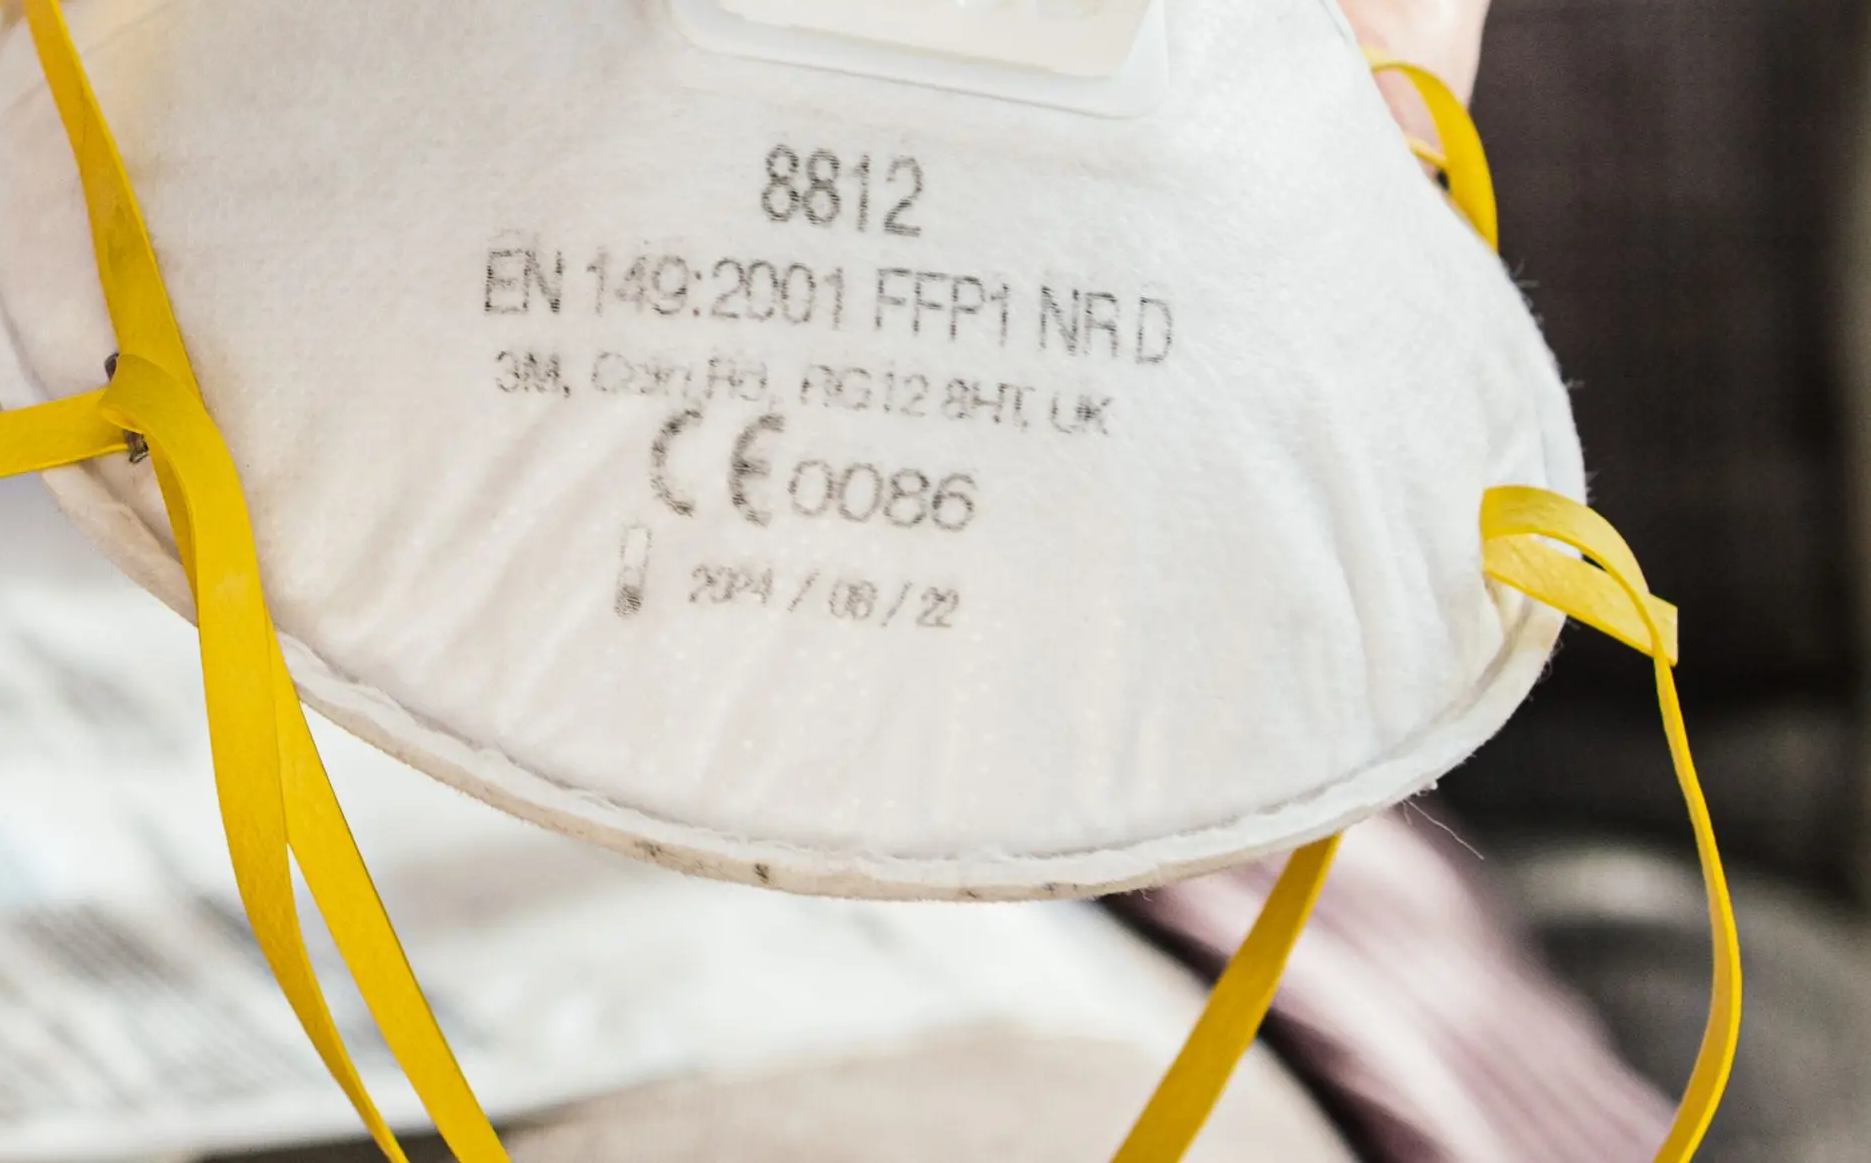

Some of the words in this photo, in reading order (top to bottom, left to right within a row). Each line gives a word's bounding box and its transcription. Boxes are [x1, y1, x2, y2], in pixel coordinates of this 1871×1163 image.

[759, 143, 925, 237] 8812
[483, 248, 563, 314] EN
[585, 245, 845, 331] 149:2001
[873, 267, 1009, 347] FFP1
[1133, 296, 1174, 364] D
[1049, 390, 1114, 436] UK
[787, 457, 979, 532] 0086
